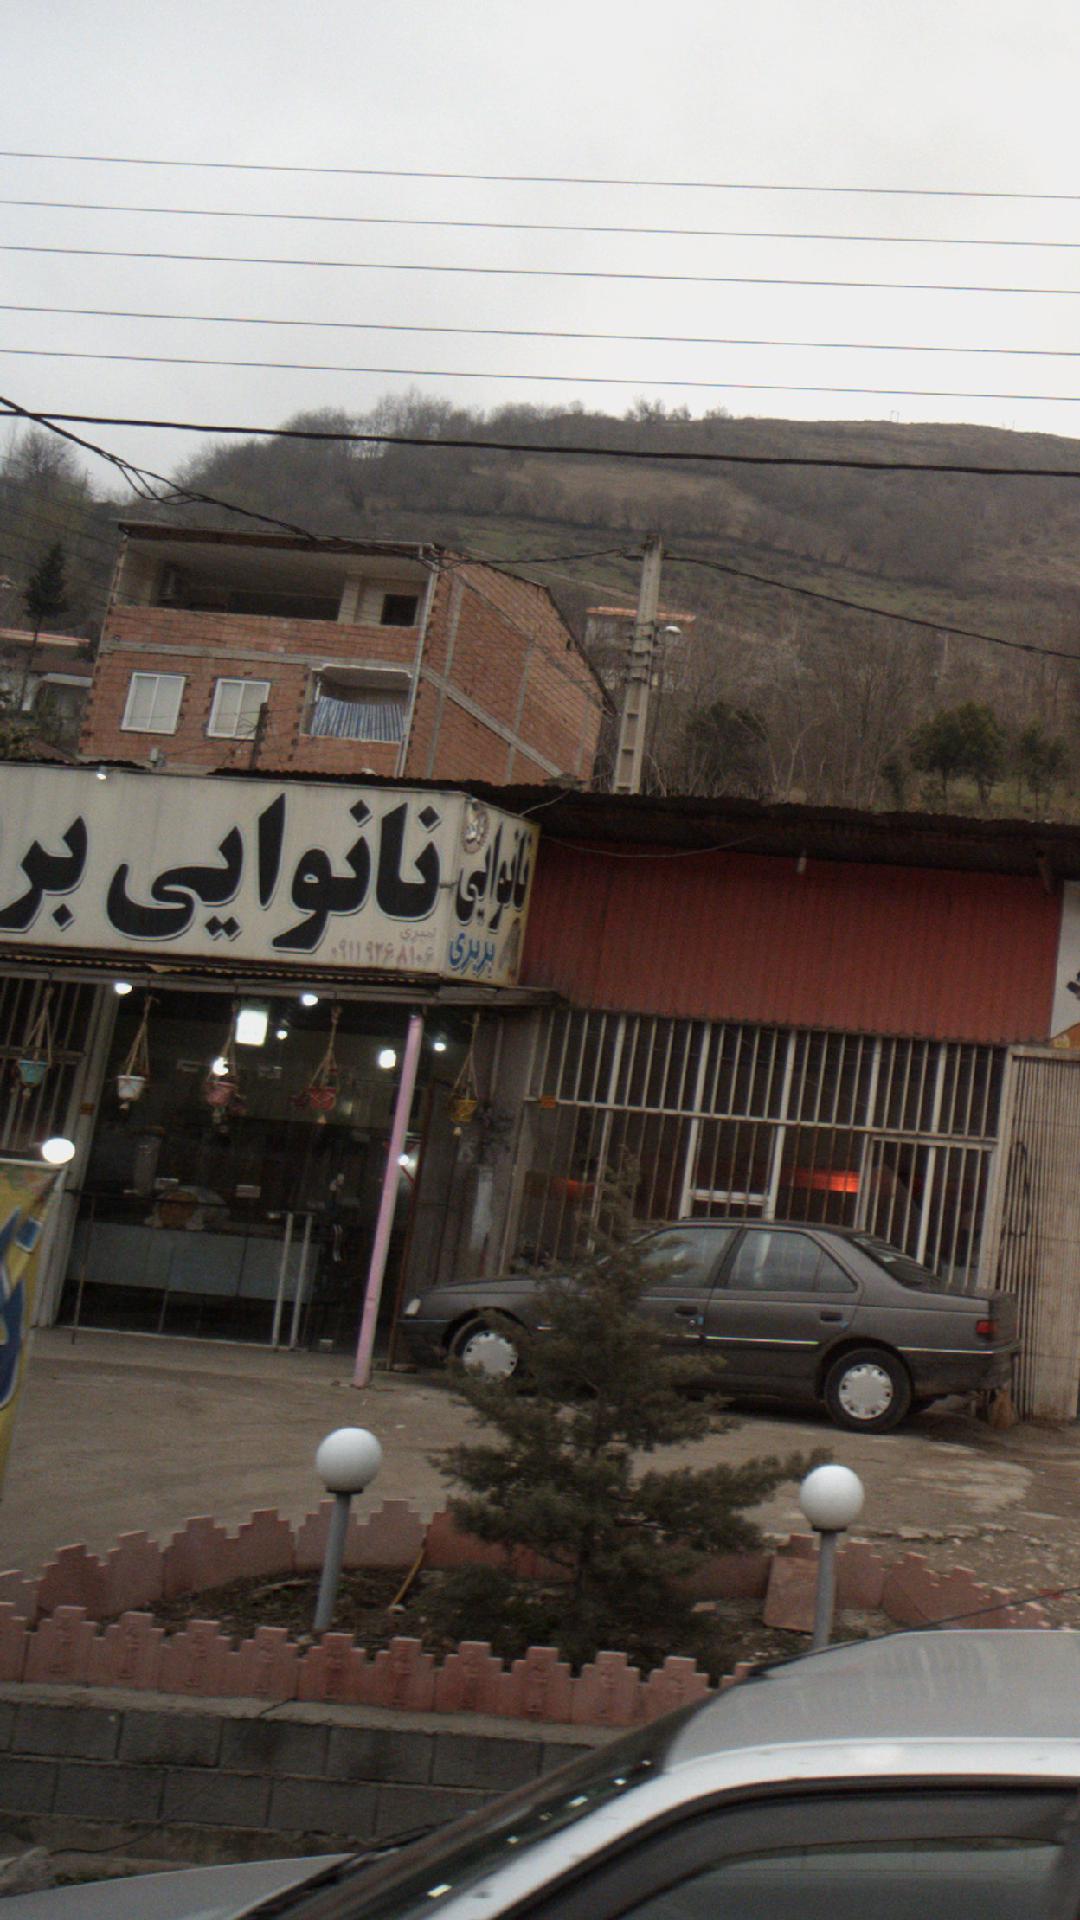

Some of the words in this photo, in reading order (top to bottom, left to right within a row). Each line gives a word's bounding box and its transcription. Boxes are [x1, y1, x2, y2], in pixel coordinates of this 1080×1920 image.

[107, 793, 441, 954] نانوایی
[455, 820, 532, 934] نانوایی
[449, 932, 496, 978] بربری
